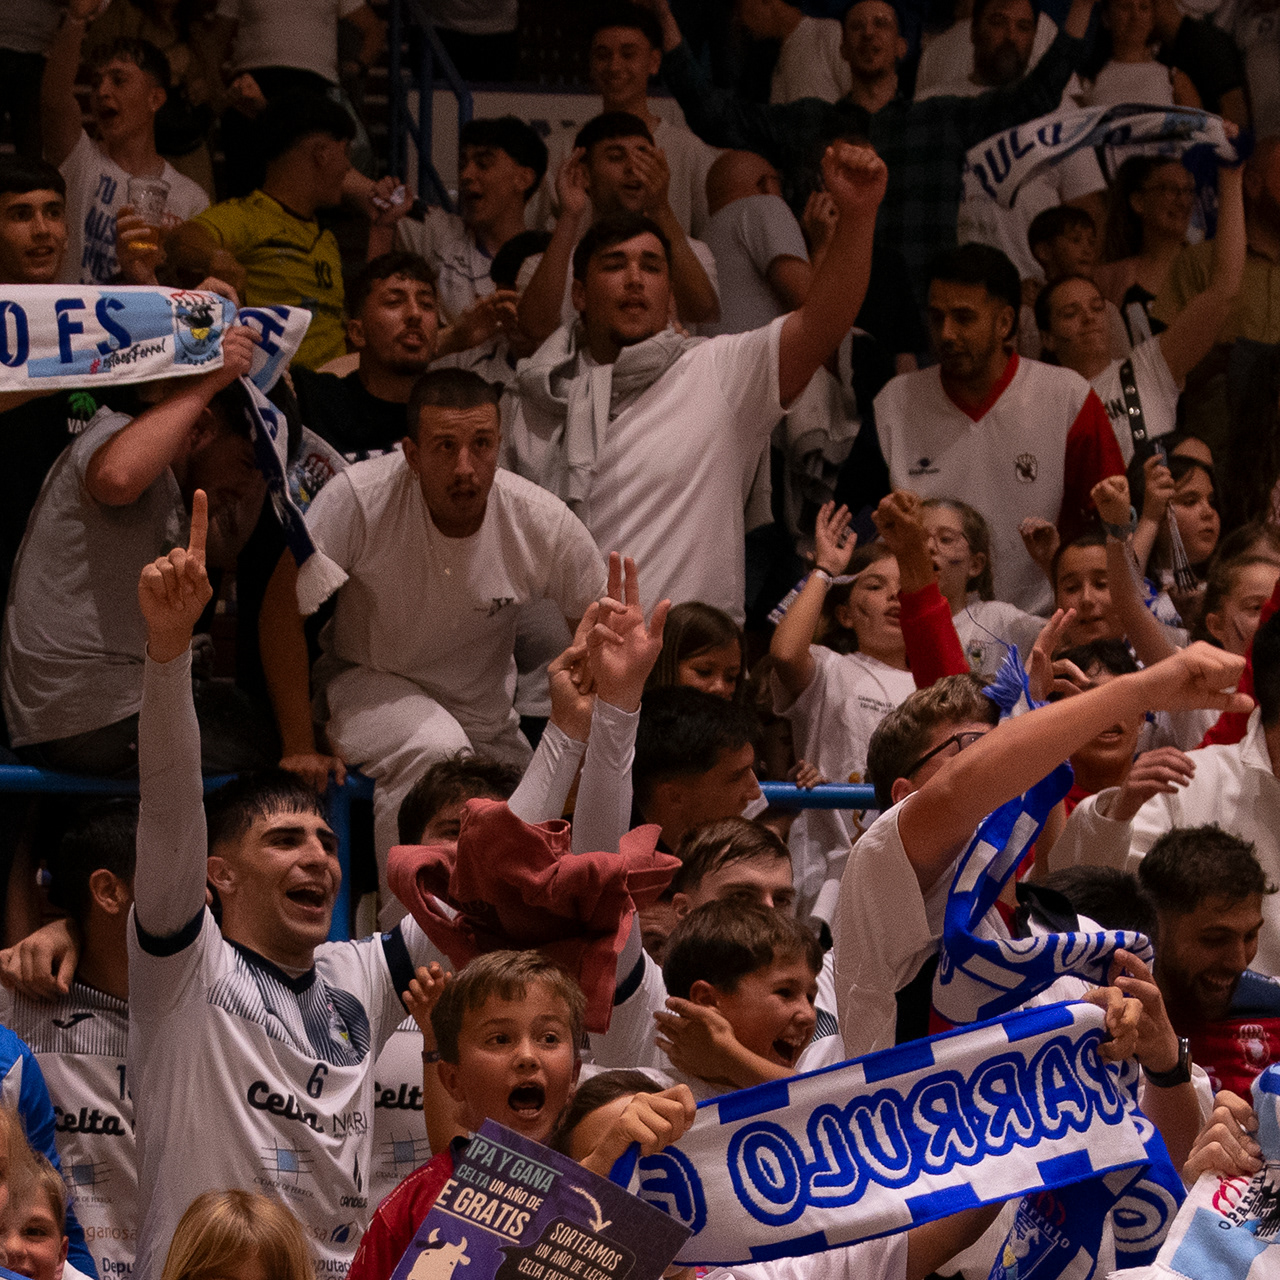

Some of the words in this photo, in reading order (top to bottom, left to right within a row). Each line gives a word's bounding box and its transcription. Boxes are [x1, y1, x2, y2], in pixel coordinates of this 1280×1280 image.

[55, 296, 132, 363] FS
[306, 1062, 329, 1099] 6
[456, 1163, 490, 1188] CELTA
[489, 1178, 503, 1194] UN
[504, 1185, 528, 1205] AÑO
[526, 1196, 544, 1212] DE
[497, 1153, 508, 1172] Y
[509, 1157, 555, 1194] GANA
[453, 1186, 531, 1237] GRATIS
[518, 1257, 544, 1280] CELTA
[535, 1243, 551, 1260] UN
[551, 1248, 572, 1273] AÑO
[572, 1257, 584, 1275] DE
[550, 1222, 623, 1271] SORTEAMOS
